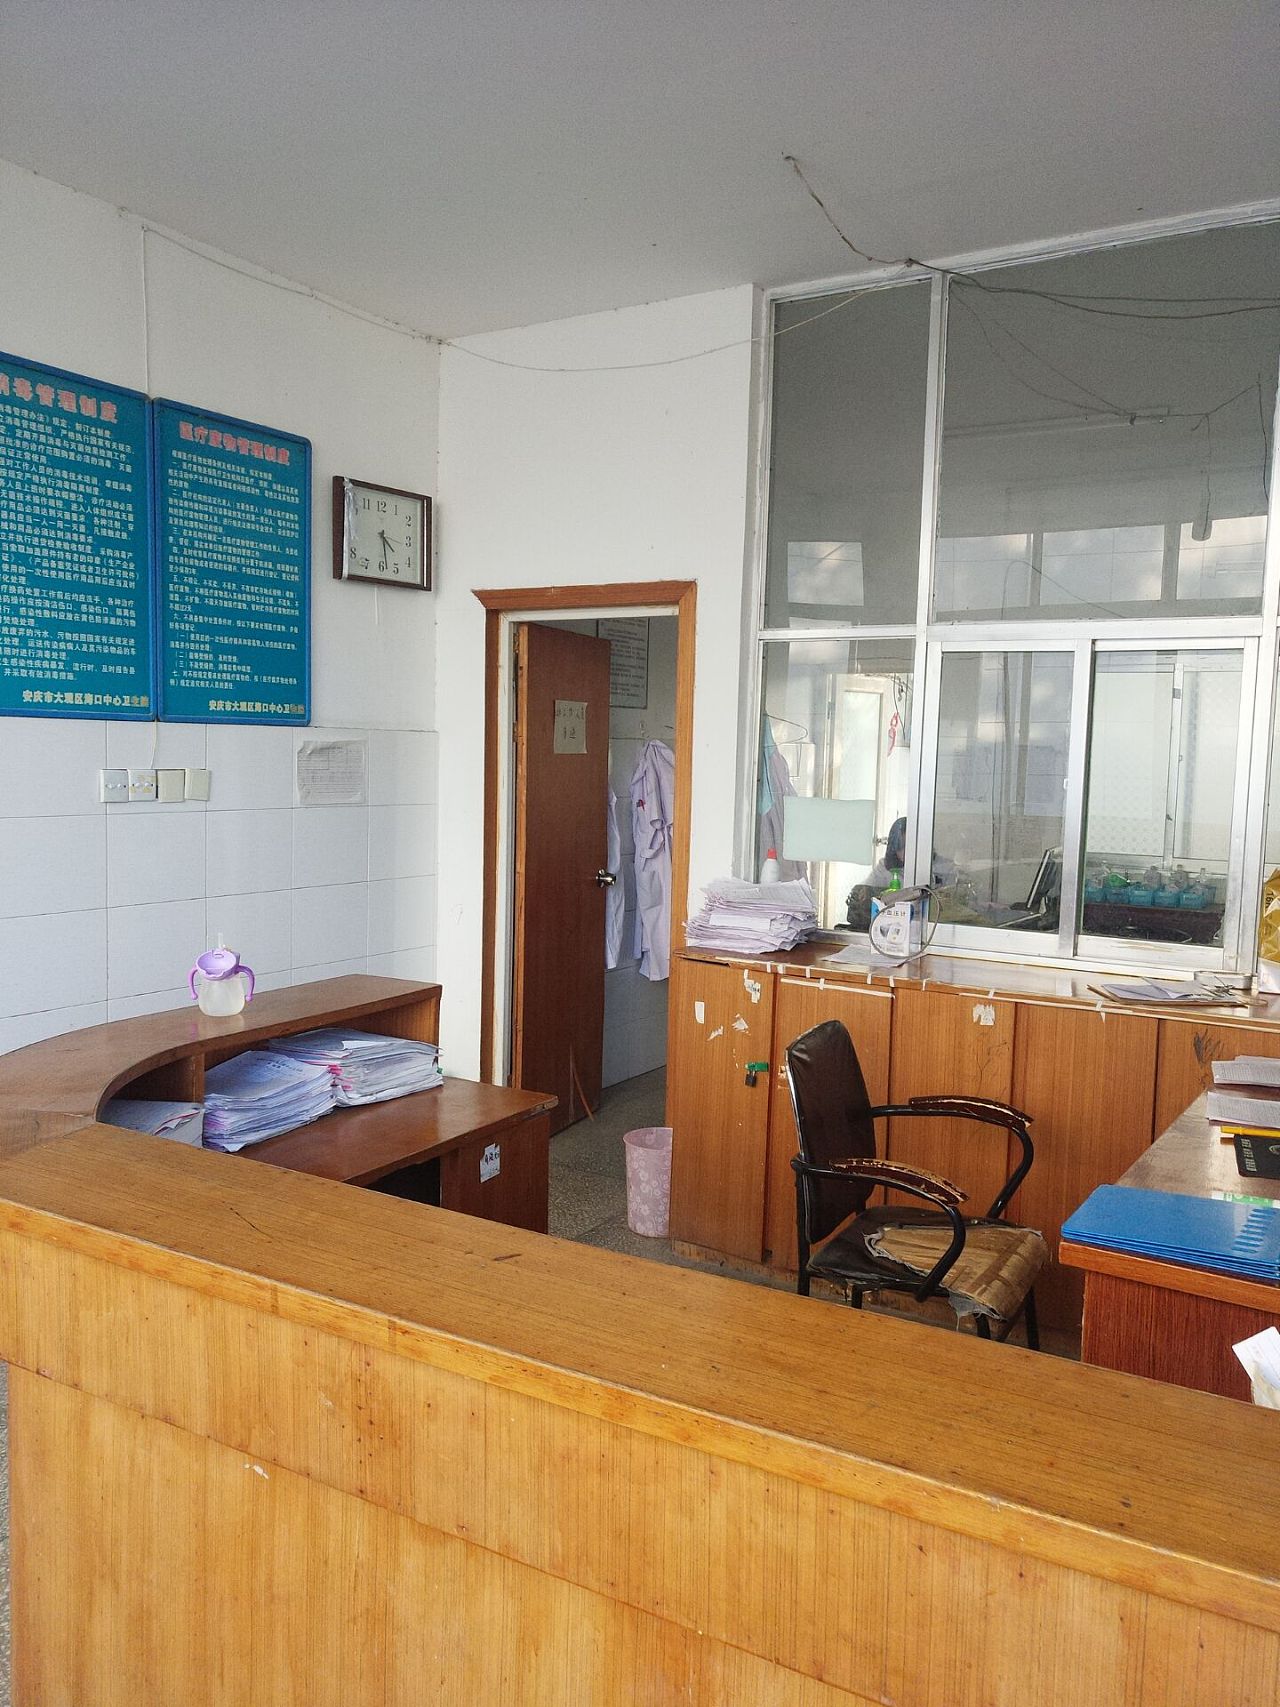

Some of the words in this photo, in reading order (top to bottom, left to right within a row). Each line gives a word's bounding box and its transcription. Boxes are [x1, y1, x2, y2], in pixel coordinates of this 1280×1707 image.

[362, 498, 370, 510] 11
[377, 500, 387, 513] 12
[405, 515, 412, 527] 2
[405, 535, 412, 547] 3
[350, 546, 357, 559] 8
[378, 560, 385, 572] 6
